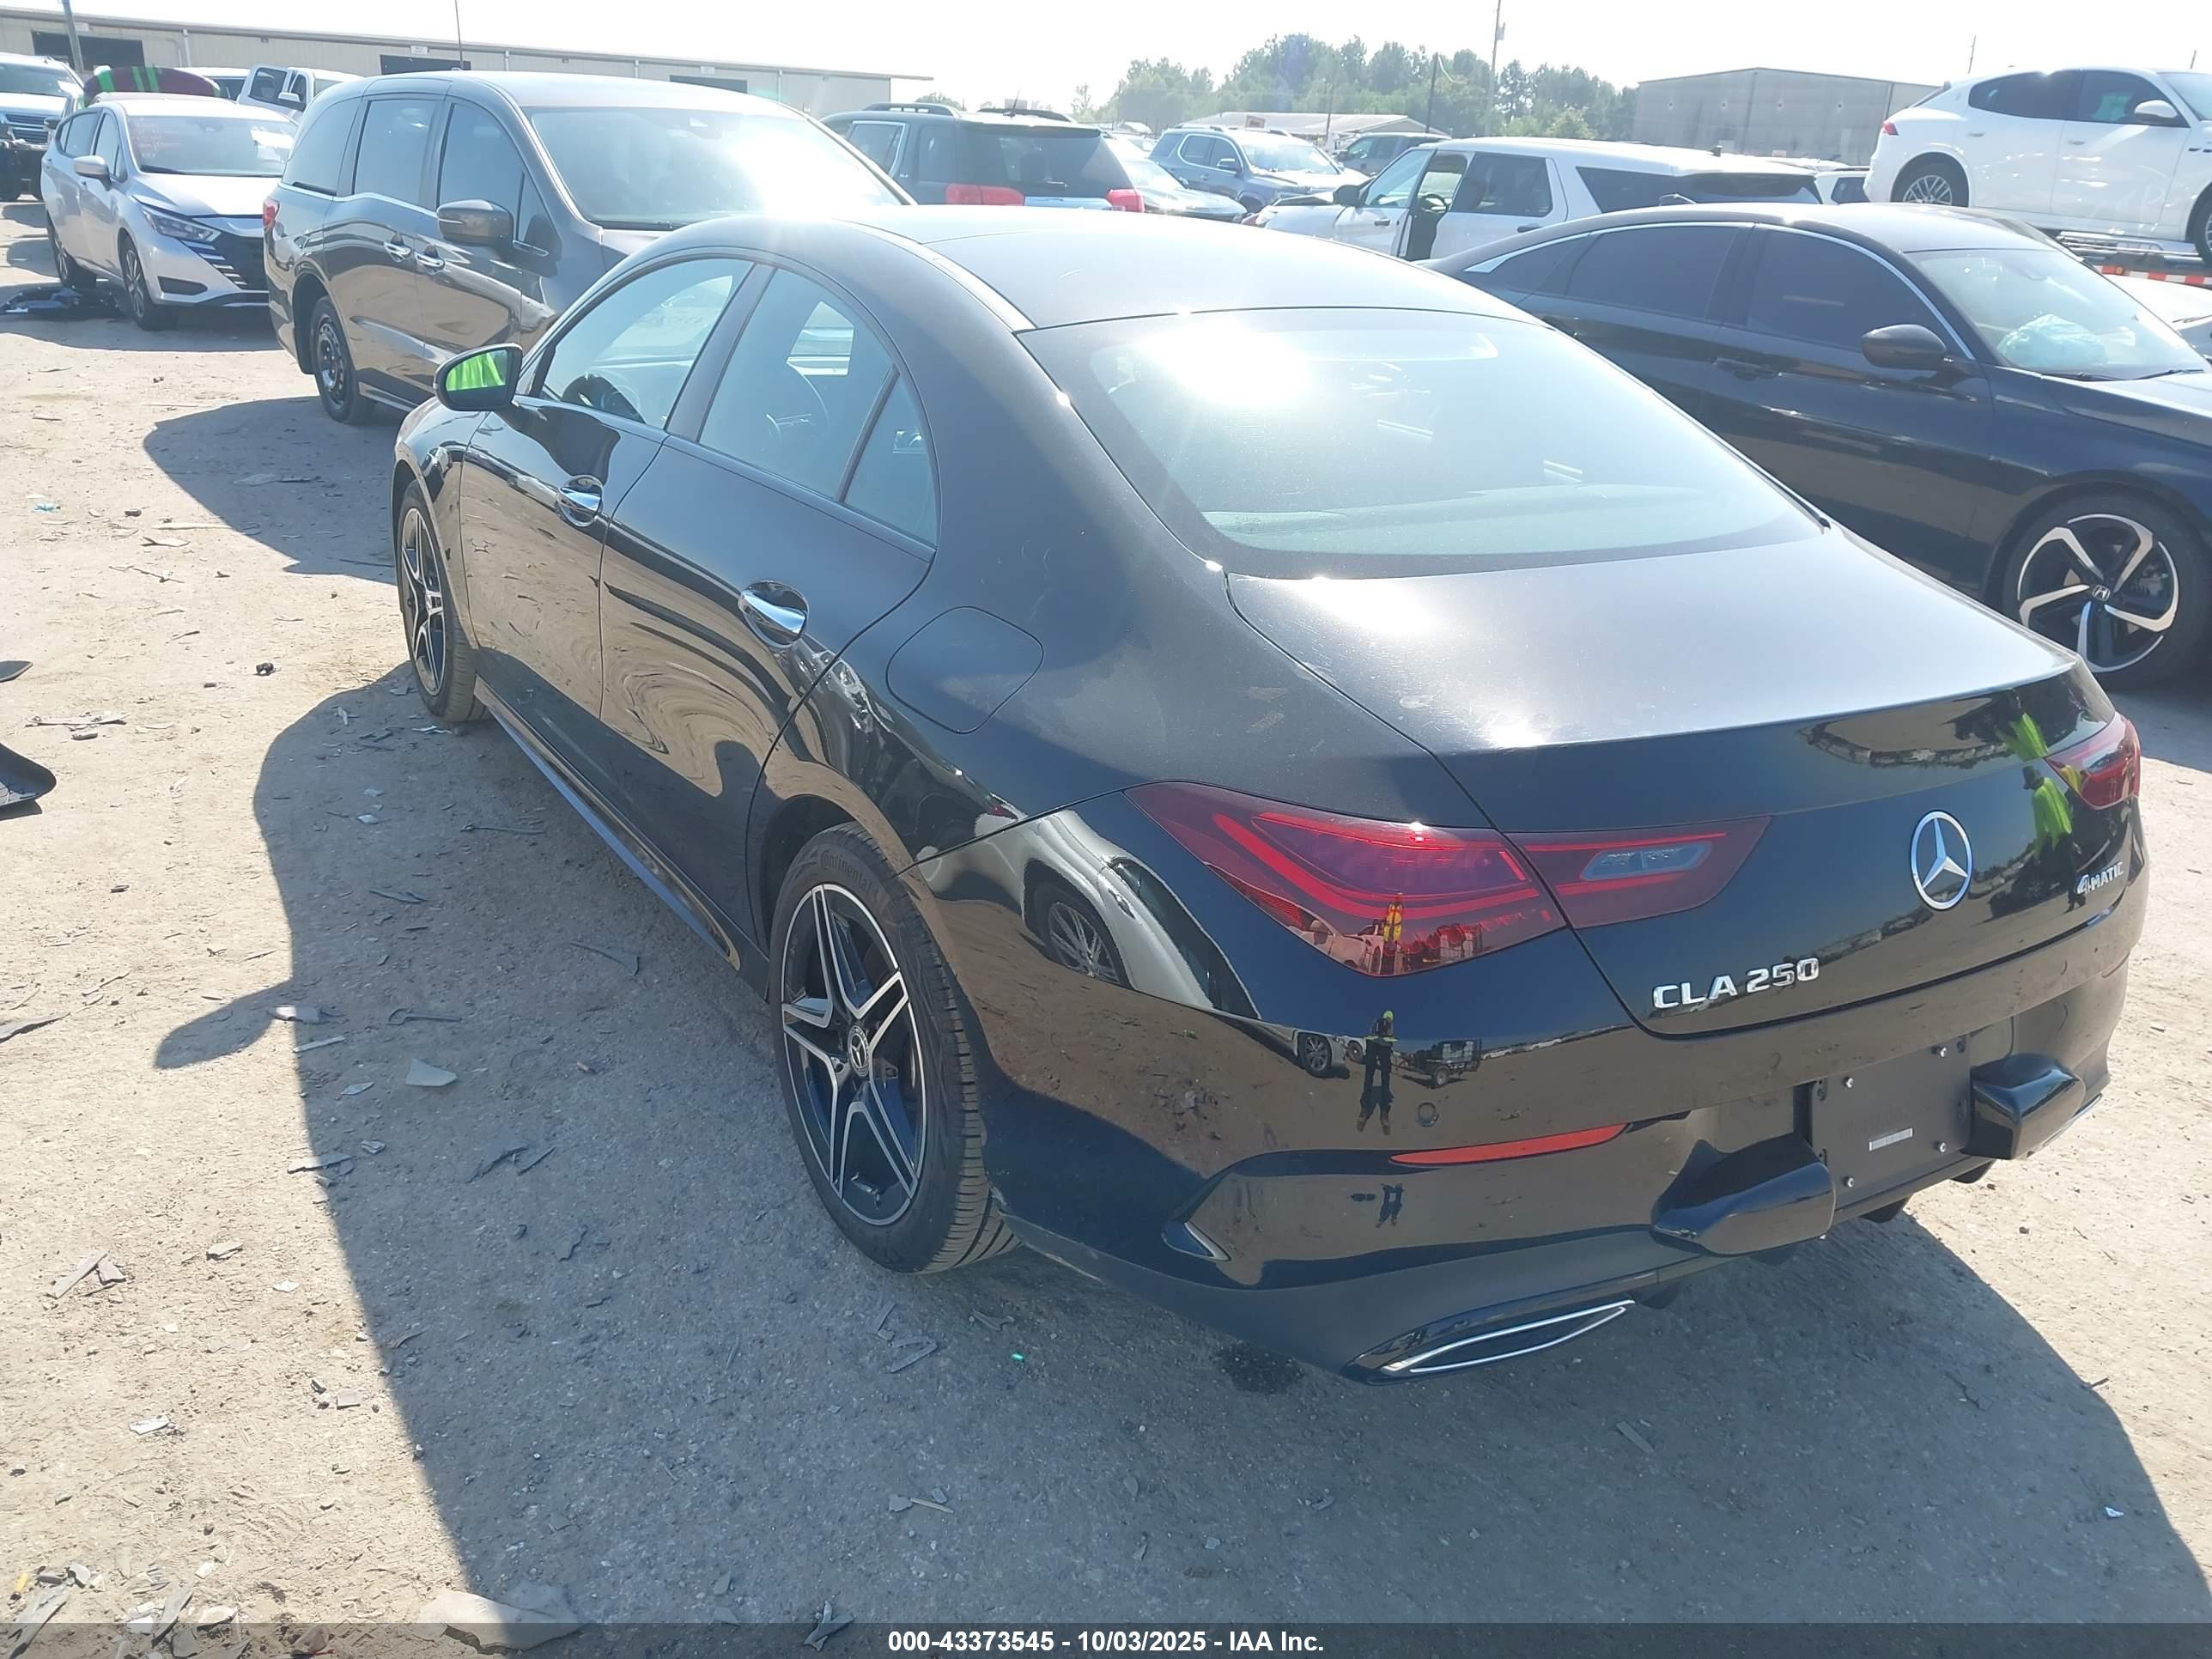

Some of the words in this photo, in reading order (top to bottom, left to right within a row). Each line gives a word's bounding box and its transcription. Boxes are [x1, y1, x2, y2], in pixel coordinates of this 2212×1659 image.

[820, 850, 873, 896] Continental
[2076, 861, 2124, 894] 4MATIC
[1653, 975, 1739, 1009] CLA
[1746, 957, 1820, 993] 250
